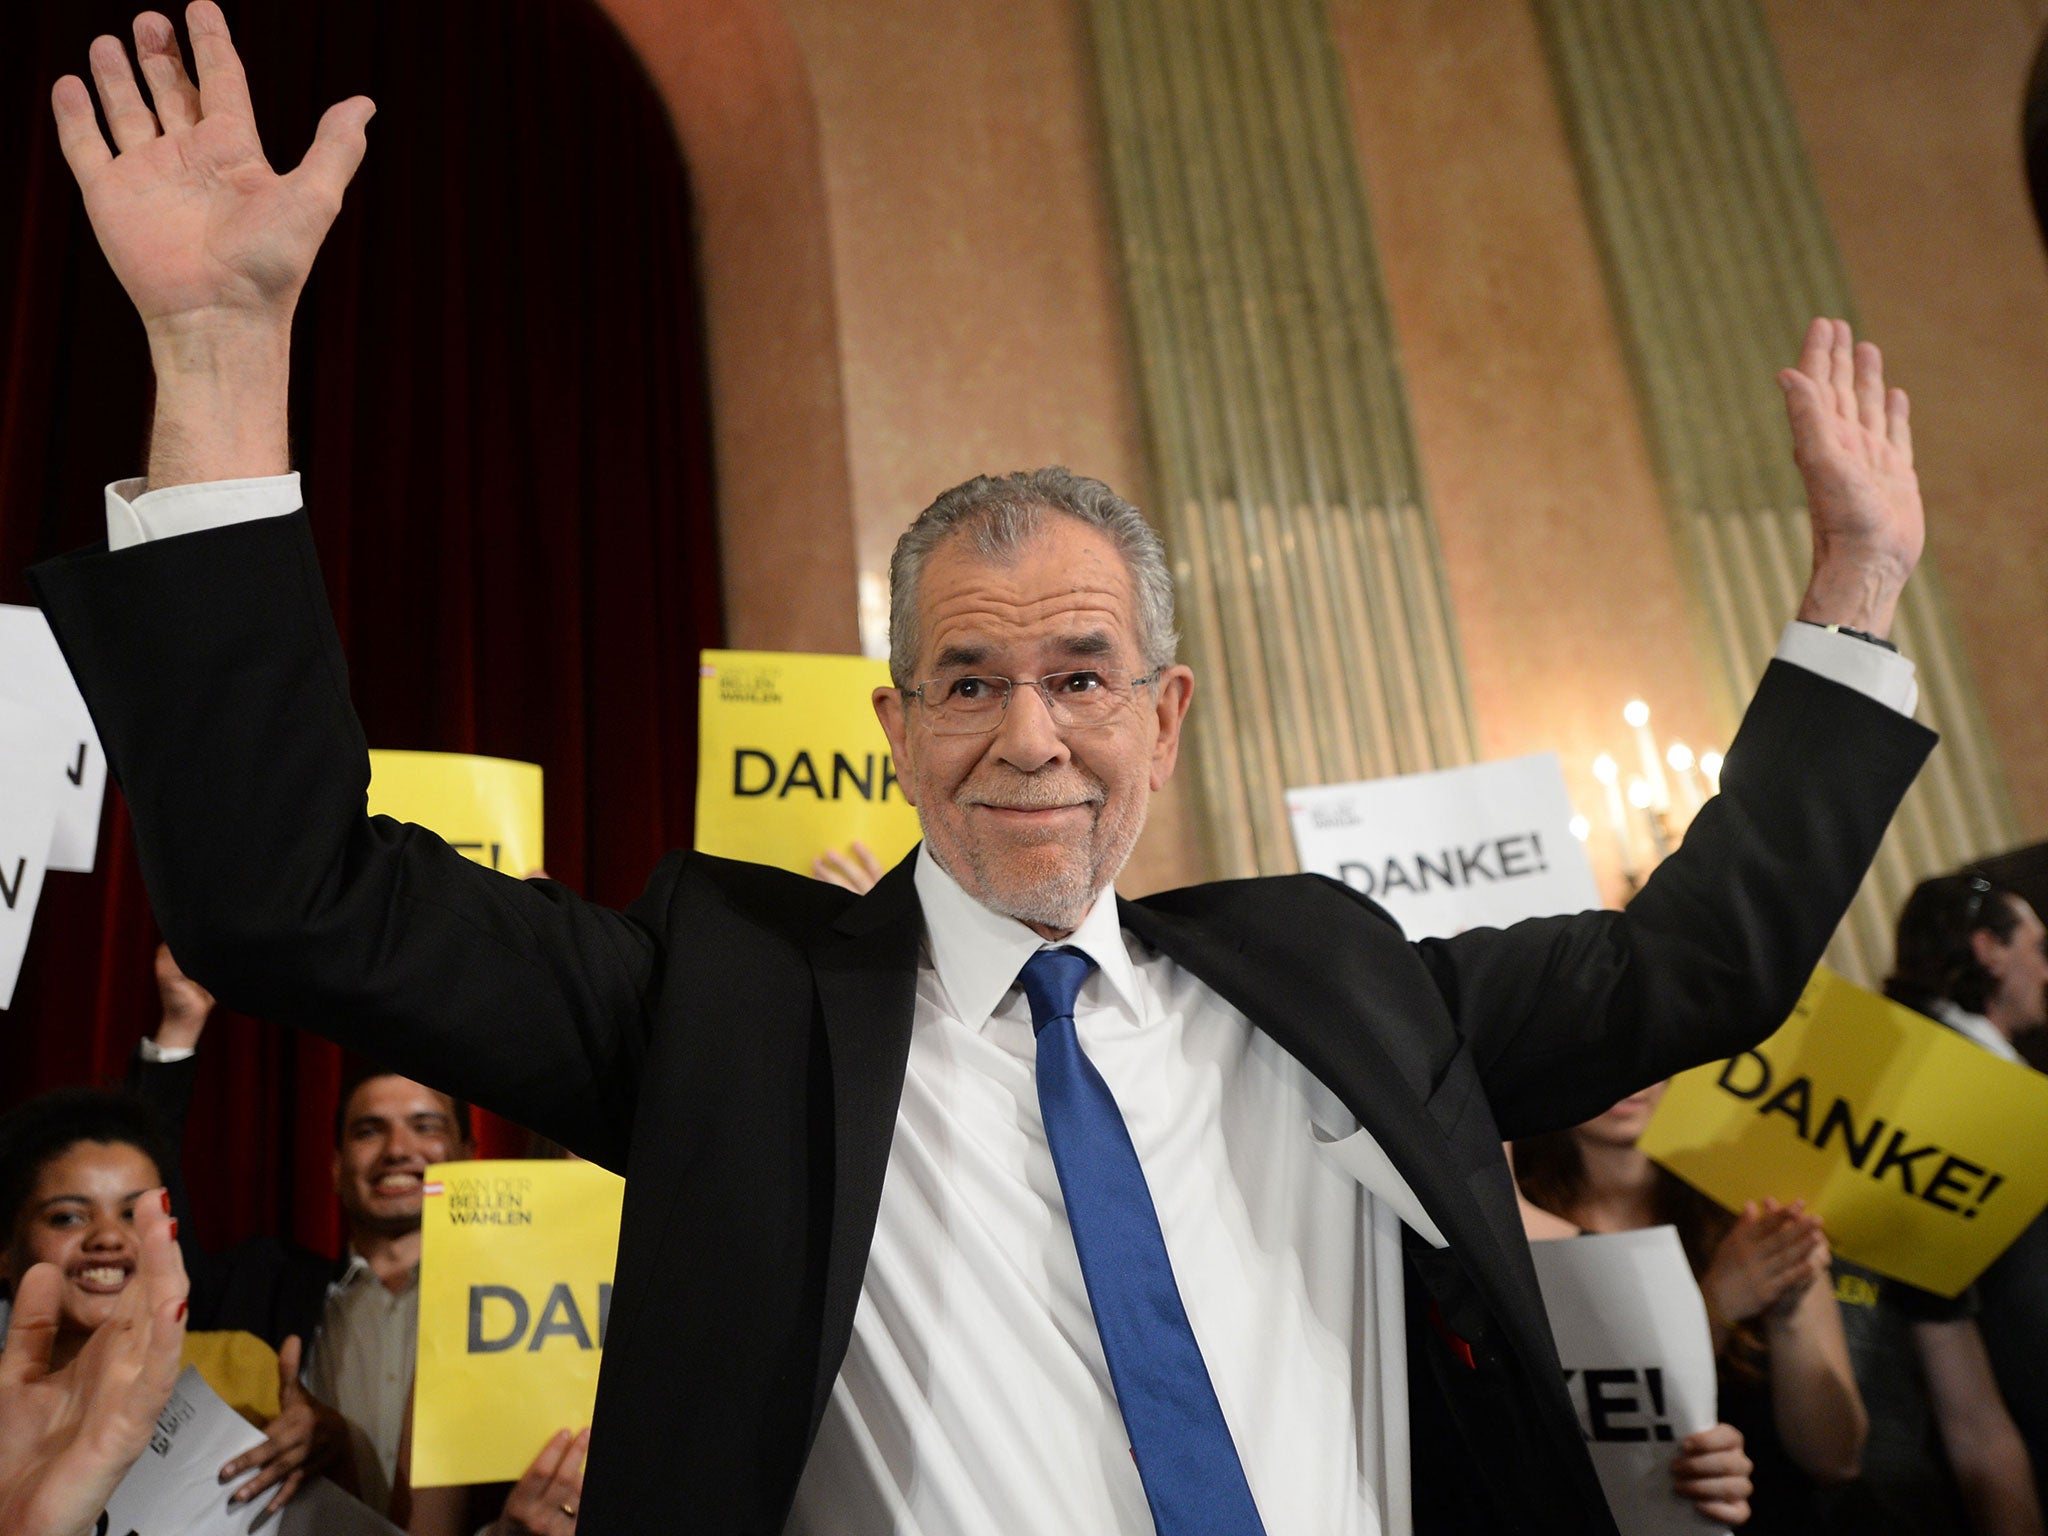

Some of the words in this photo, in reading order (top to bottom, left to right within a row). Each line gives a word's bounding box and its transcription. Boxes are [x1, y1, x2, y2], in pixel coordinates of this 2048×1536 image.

[1338, 832, 1550, 898] DANKE!
[1717, 1049, 2005, 1221] DANKE!
[449, 1178, 489, 1193] VAN
[449, 1194, 523, 1208] BELLEN
[467, 1283, 613, 1354] DA
